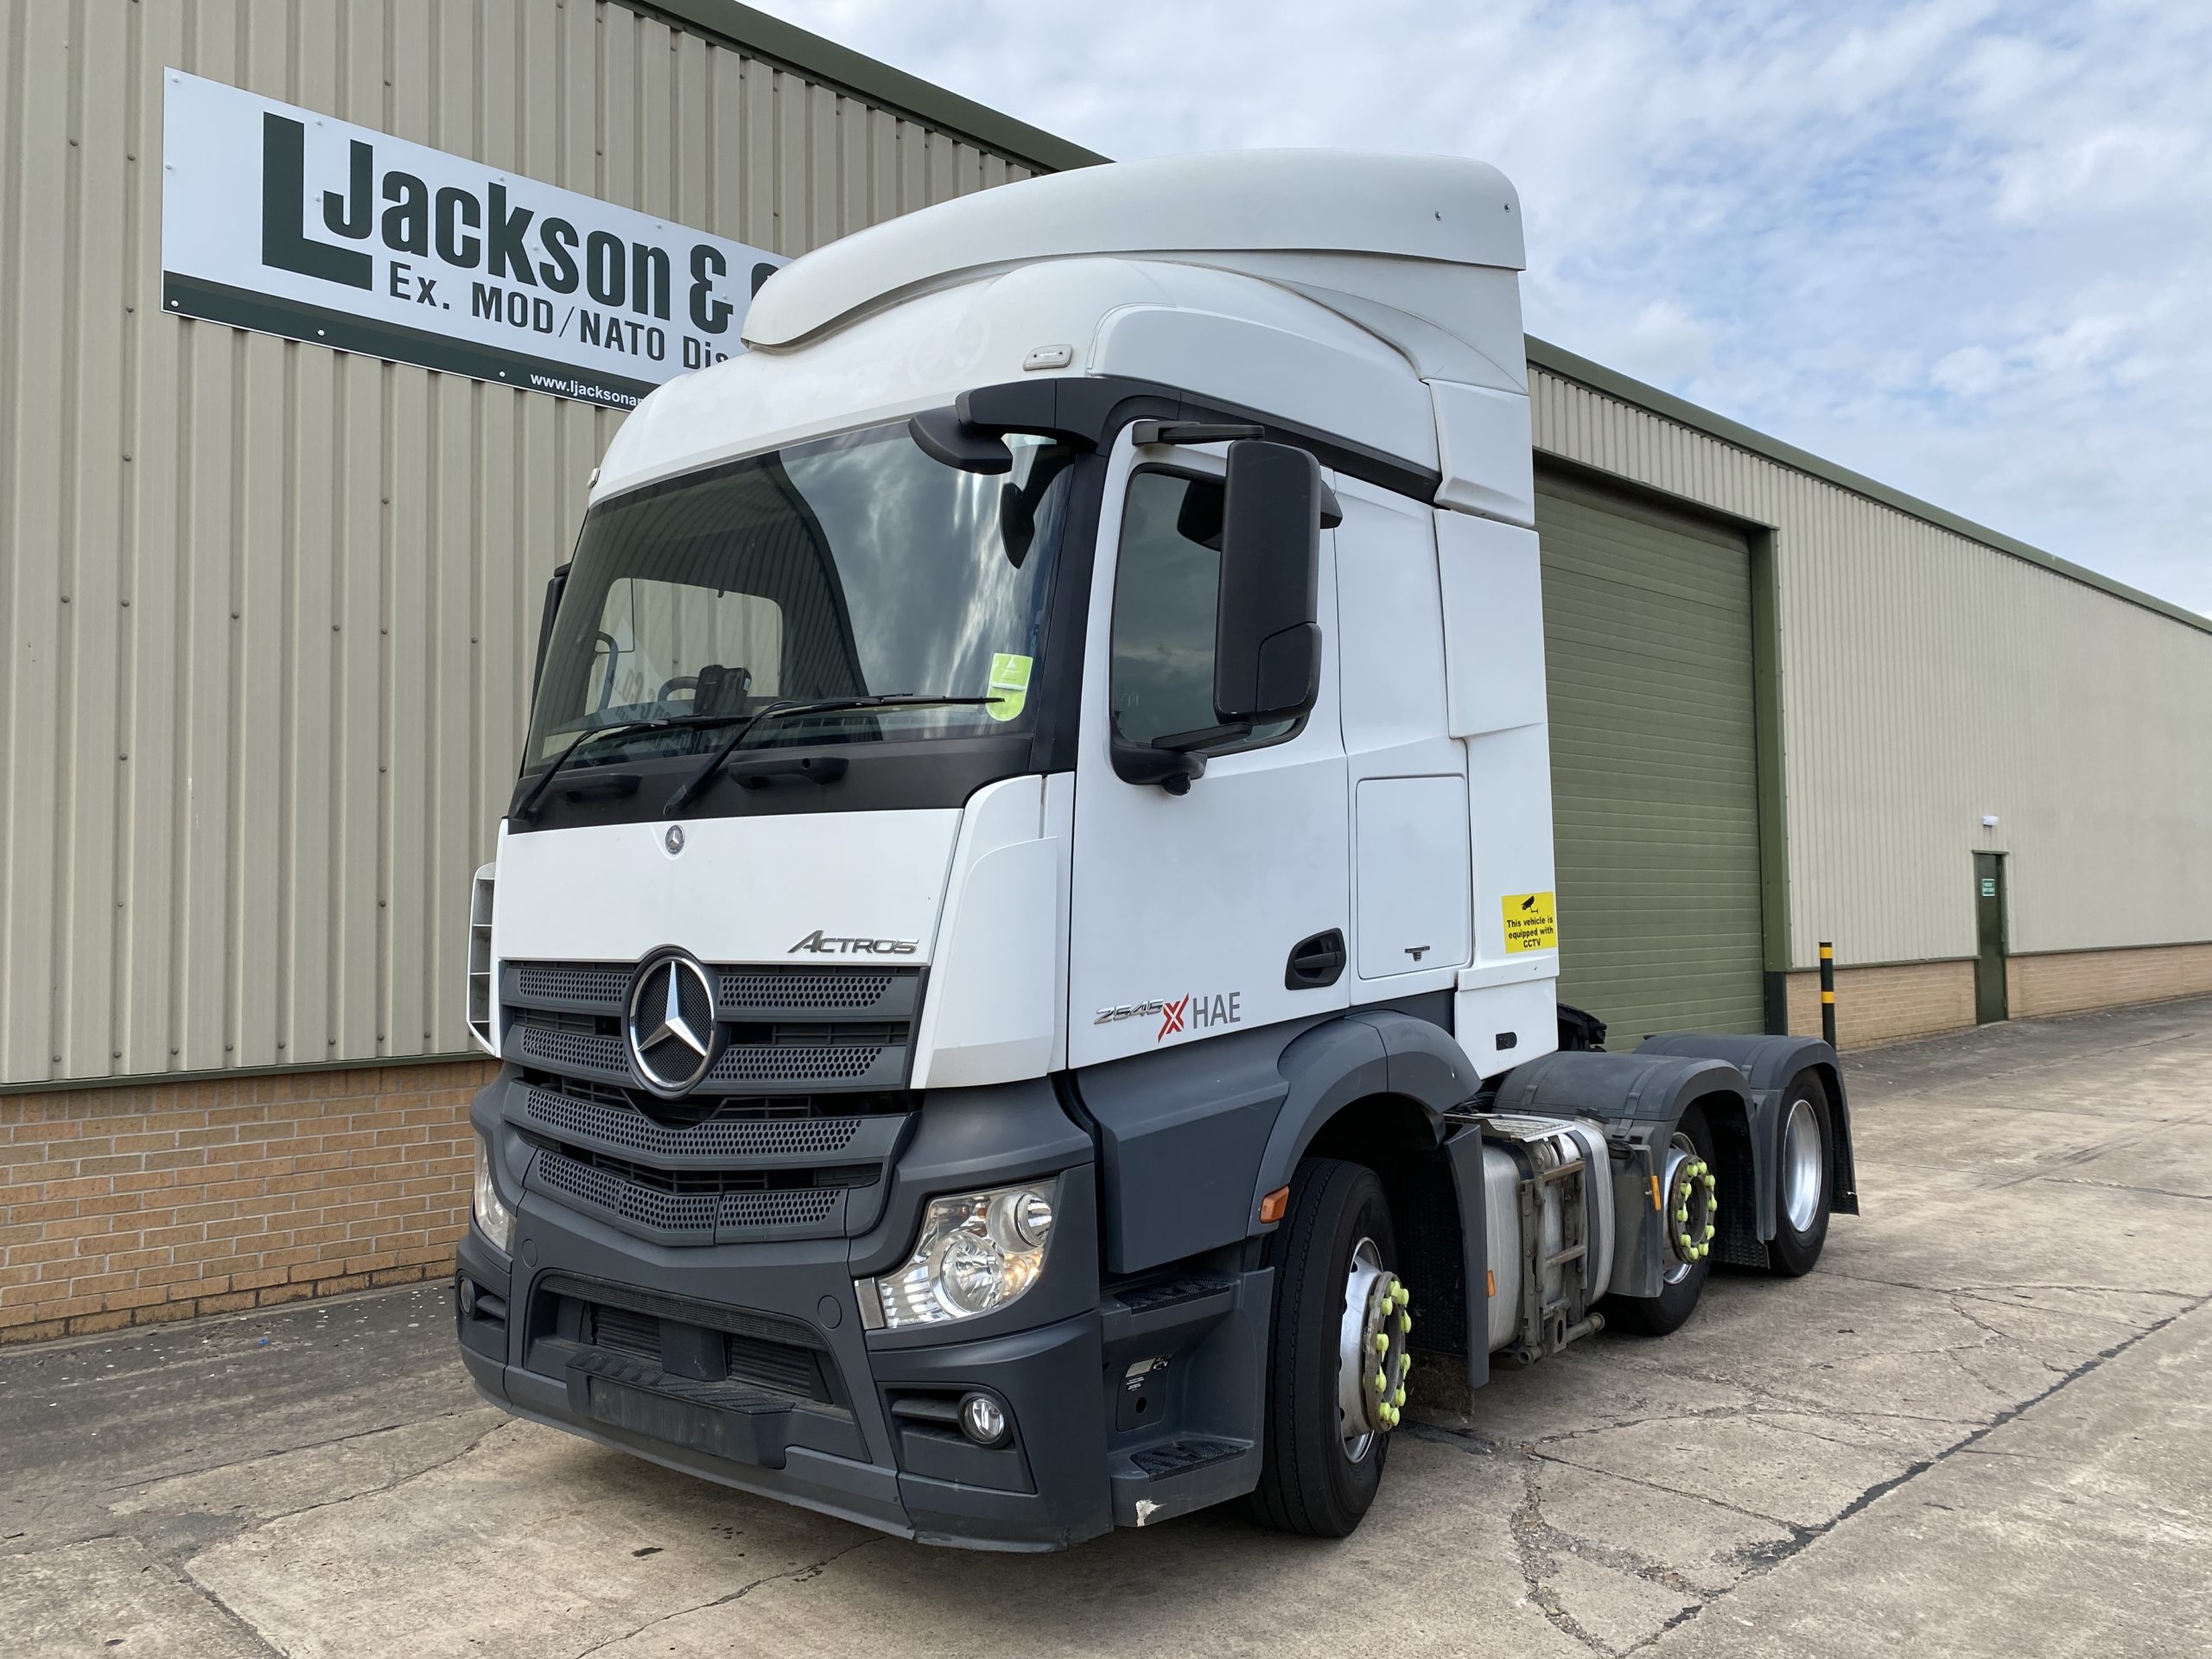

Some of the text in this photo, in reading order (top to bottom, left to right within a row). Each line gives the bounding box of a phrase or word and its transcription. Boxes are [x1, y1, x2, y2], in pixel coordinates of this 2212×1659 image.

[690, 245, 733, 334] &
[390, 261, 449, 310] Ex.
[472, 282, 664, 361] MOD/NATO
[1507, 918, 1522, 928] This
[1523, 916, 1546, 926] vehicle
[1508, 926, 1554, 940] equipped with
[1523, 938, 1541, 949] CCTV
[1094, 998, 1165, 1026] 2545
